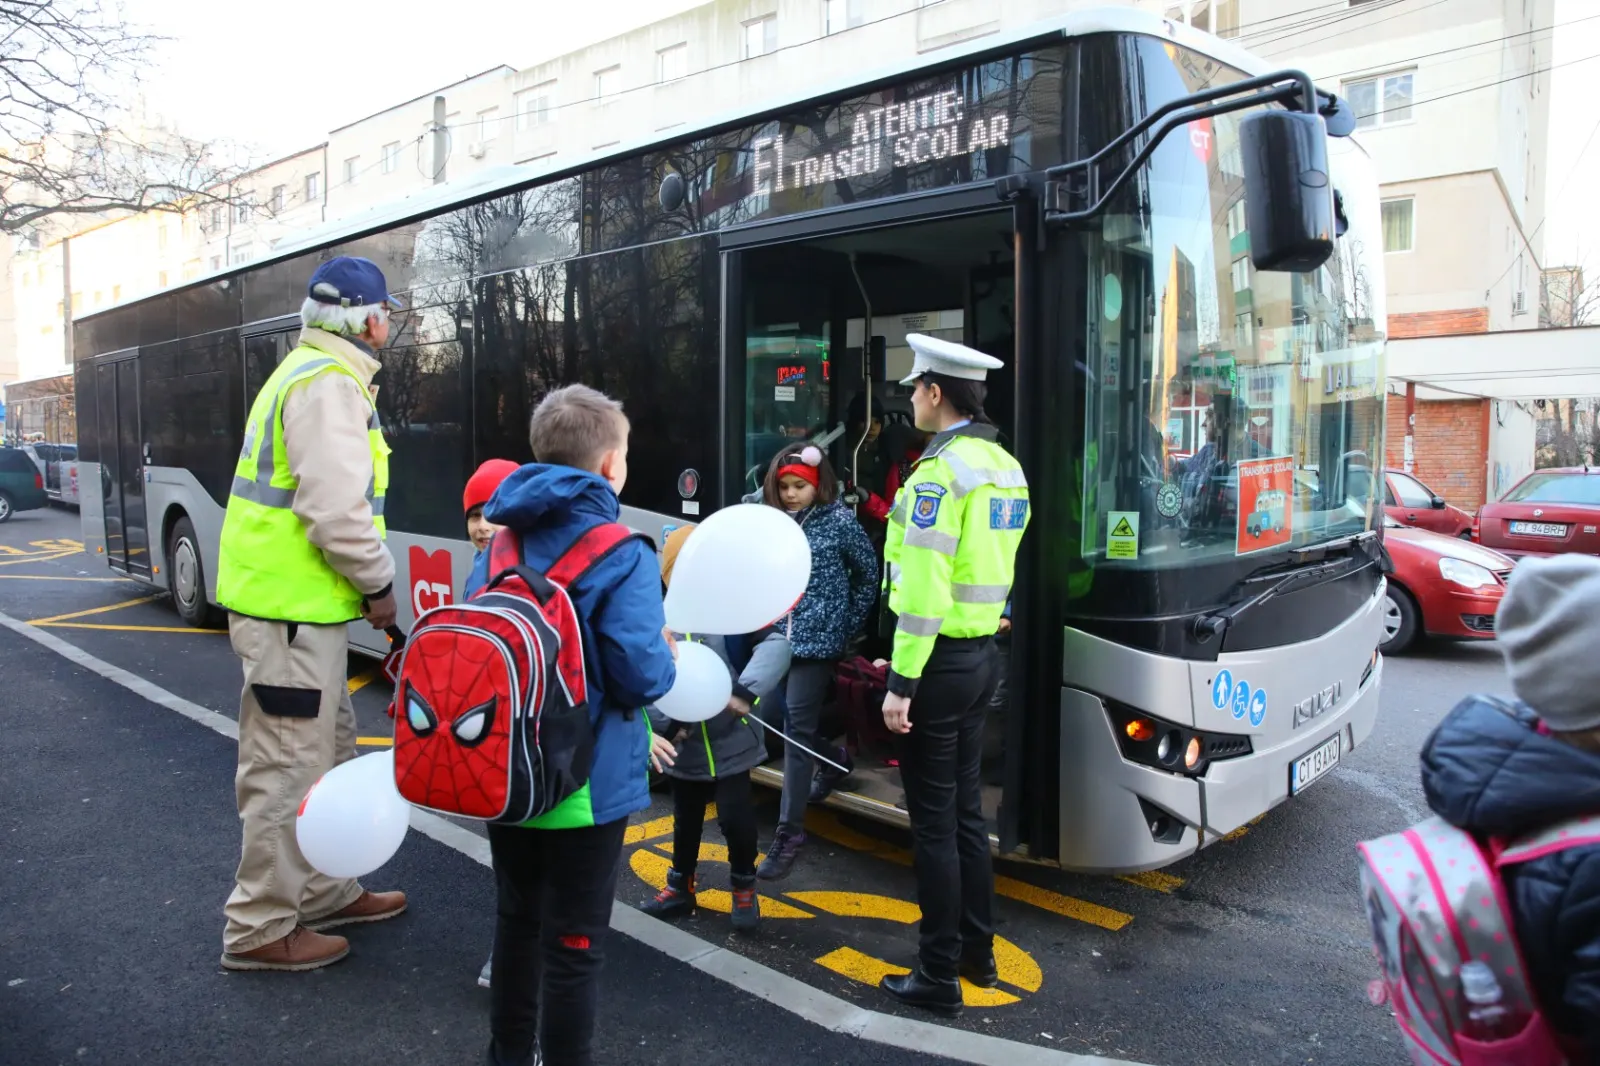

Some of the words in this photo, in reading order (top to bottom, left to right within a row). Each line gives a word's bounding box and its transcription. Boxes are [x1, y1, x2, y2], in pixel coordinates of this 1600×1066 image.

[852, 89, 963, 145] ATENTIE:
[791, 142, 880, 189] TRASEU
[894, 114, 1009, 167] SCOLAR
[1190, 129, 1211, 150] CT
[1240, 464, 1273, 477] TRANSPORT
[1516, 523, 1529, 532] CT
[413, 579, 451, 617] CT
[1292, 679, 1343, 730] ISUZU
[1299, 758, 1311, 783] CT
[1313, 751, 1322, 773] 13
